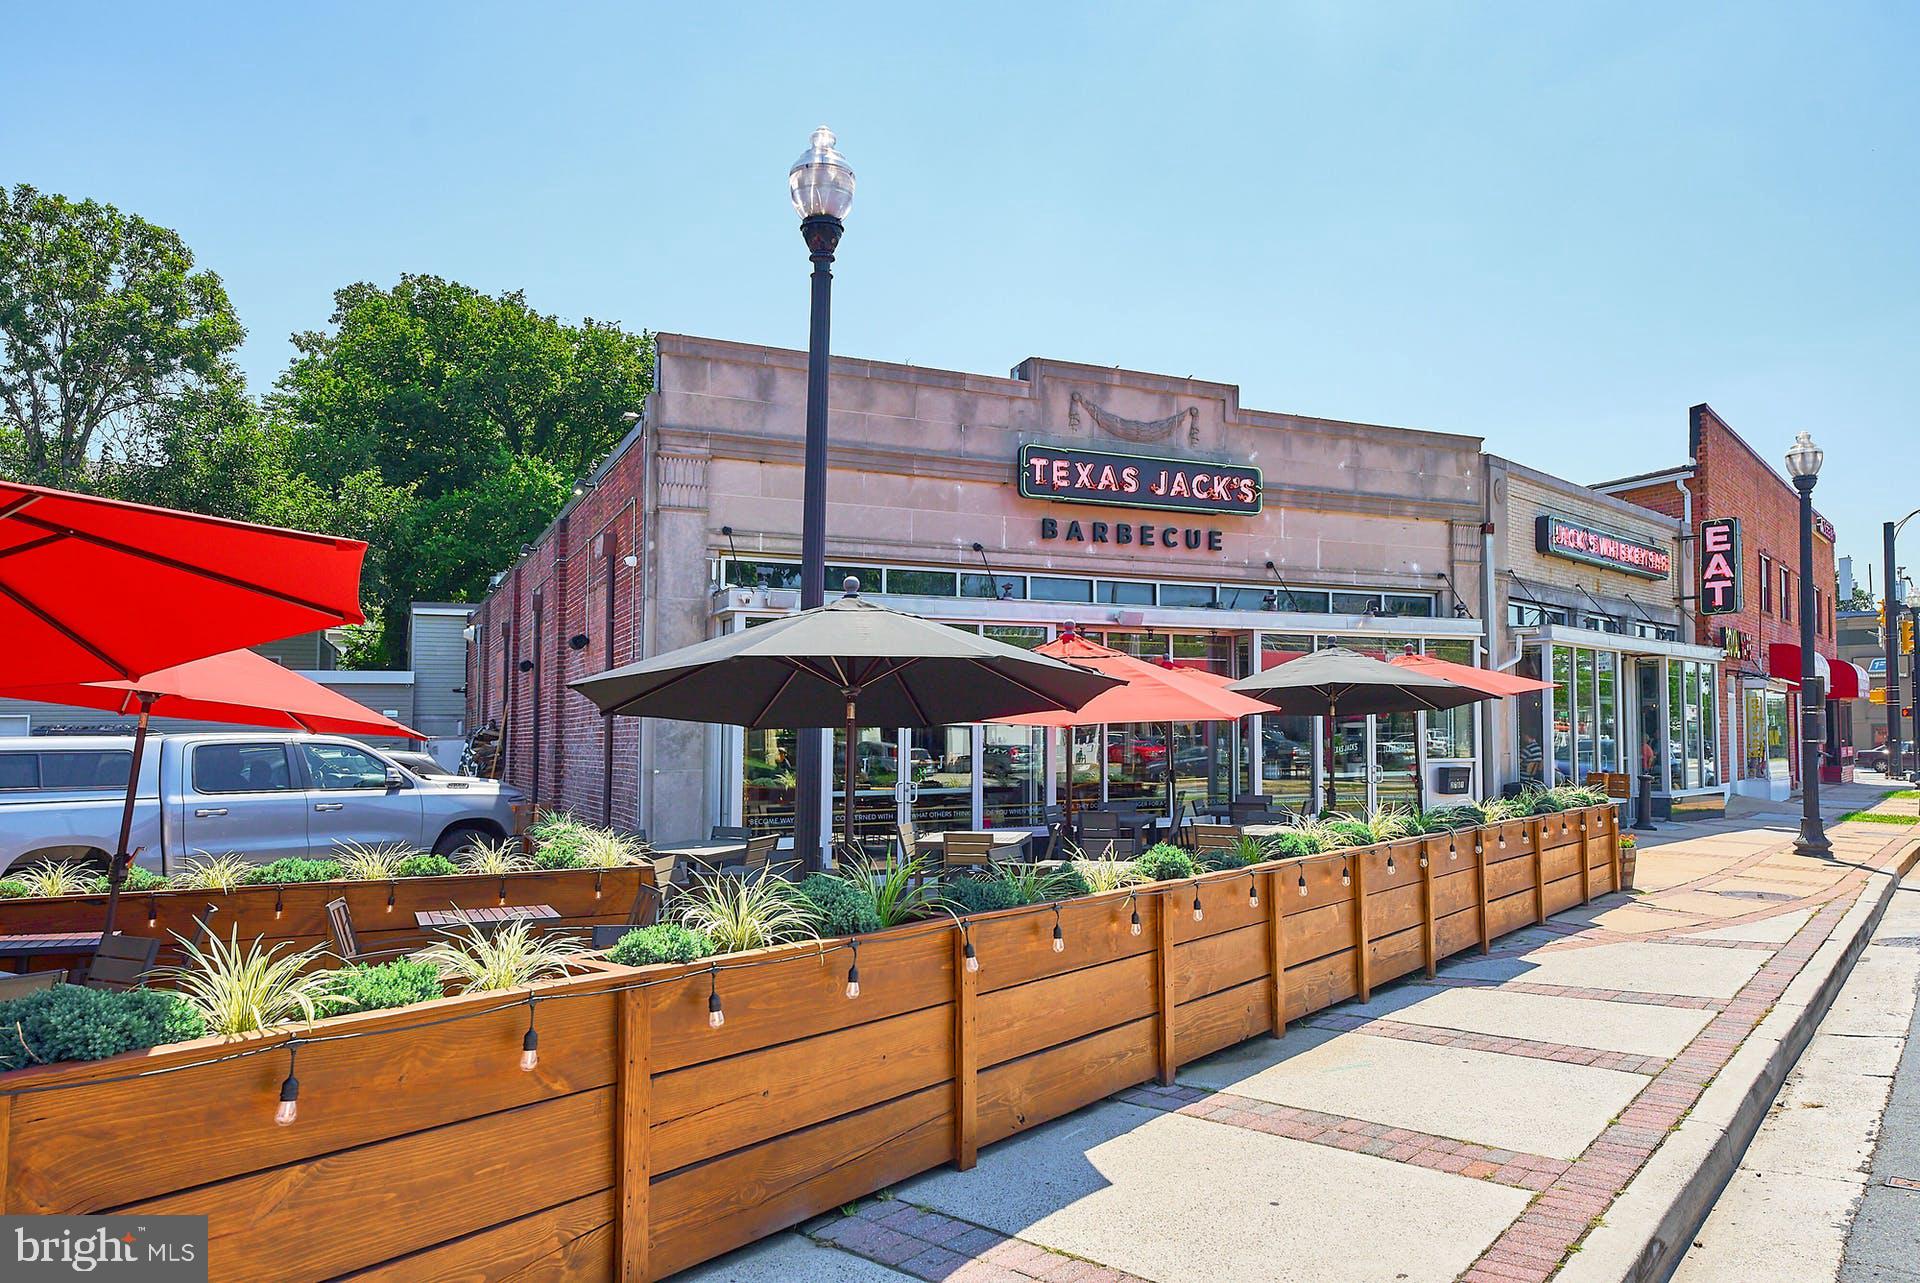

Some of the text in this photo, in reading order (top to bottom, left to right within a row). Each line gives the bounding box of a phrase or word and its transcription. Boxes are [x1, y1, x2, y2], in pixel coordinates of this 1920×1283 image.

[1030, 457, 1256, 503] TEXAS JACK'S
[1042, 518, 1222, 550] BARBECUE
[1703, 525, 1734, 606] EAT
[750, 816, 795, 825] BECOME WAY
